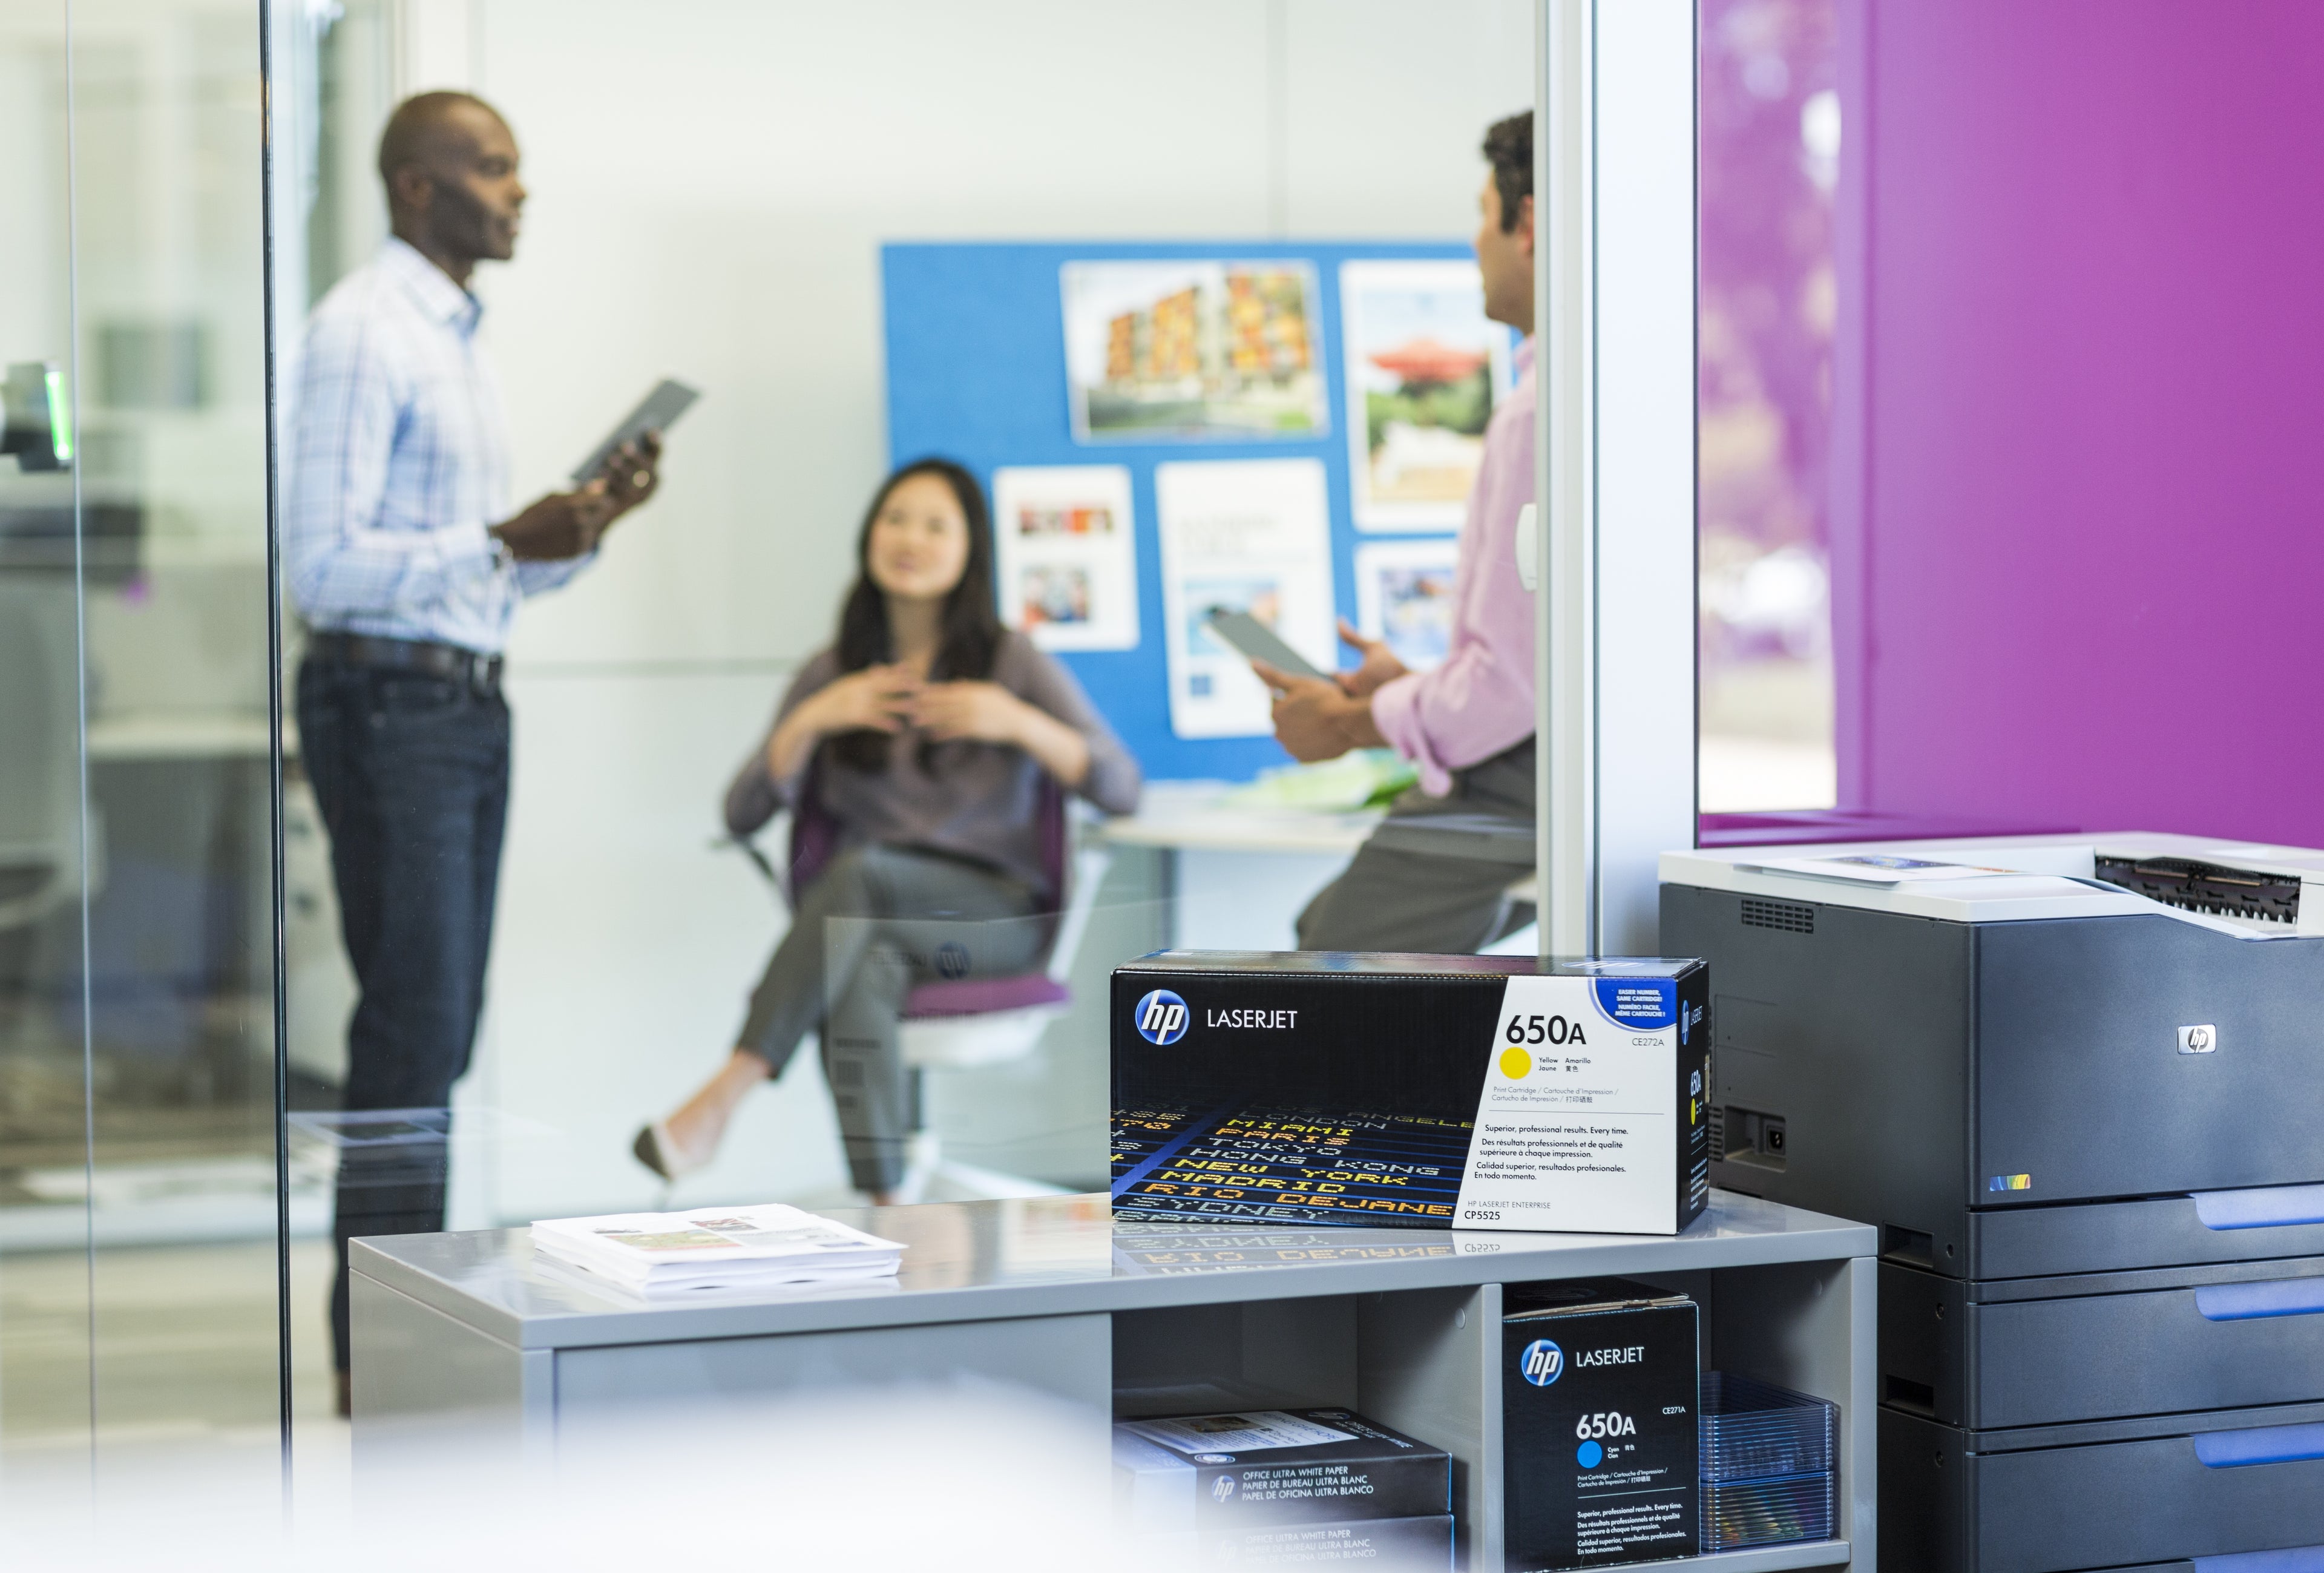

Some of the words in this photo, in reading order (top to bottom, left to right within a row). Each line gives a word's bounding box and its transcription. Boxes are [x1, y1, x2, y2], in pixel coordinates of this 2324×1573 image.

[1141, 989, 1185, 1045] hp
[1207, 1009, 1298, 1028] LASERJET
[1506, 1014, 1586, 1045] 650A
[1632, 1038, 1664, 1046] CE272A
[2190, 1025, 2207, 1053] hp
[1691, 1069, 1701, 1097] 650A
[1227, 1119, 1353, 1136] MIAMI
[1239, 1110, 1387, 1129] LONDON
[1216, 1128, 1350, 1145] PARIS
[1485, 1125, 1517, 1133] Superior,
[1519, 1125, 1561, 1134] professional
[1590, 1127, 1610, 1135] Every
[1209, 1138, 1341, 1155] TOKYO
[1528, 1140, 1578, 1149] professionnels
[1598, 1141, 1623, 1150] qualité
[1190, 1148, 1307, 1164] HONG
[1334, 1160, 1440, 1175] KONG
[1480, 1149, 1517, 1157] supérieure
[1525, 1149, 1551, 1158] chaque
[1552, 1150, 1593, 1159] impression.
[1175, 1159, 1268, 1174] NEW
[1301, 1169, 1408, 1185] YORK
[1506, 1163, 1537, 1172] superior,
[1539, 1163, 1575, 1172] resultados
[1577, 1164, 1626, 1173] profesionales.
[1160, 1171, 1345, 1193] MADRID
[1144, 1183, 1244, 1199] RIO
[1128, 1197, 1329, 1219] SYDNEY
[1465, 1210, 1500, 1220] CP5525
[1526, 1340, 1560, 1386] hp
[1577, 1346, 1644, 1367] LASERJET
[1662, 1405, 1686, 1415] CE271A
[1576, 1412, 1636, 1440] 650A
[1243, 1471, 1270, 1480] OFFICE
[1273, 1470, 1296, 1478] ULTRA
[1298, 1468, 1323, 1477] WHITE
[1325, 1466, 1348, 1475] PAPER
[1213, 1475, 1235, 1503] hp
[1243, 1482, 1267, 1491] PAPIER
[1270, 1480, 1280, 1489] DE
[1282, 1479, 1313, 1488] BUREAU
[1316, 1477, 1338, 1486] ULTRA
[1341, 1475, 1367, 1485] BLANC
[1242, 1492, 1264, 1501] PAPEL
[1279, 1489, 1313, 1499] OFICINA
[1315, 1488, 1338, 1497] ULTRA
[1341, 1485, 1374, 1495] BLANCO
[1603, 1506, 1635, 1517] professional
[1611, 1516, 1648, 1526] professionnels
[1662, 1513, 1680, 1522] qualité
[1246, 1535, 1273, 1544] OFFICE
[1276, 1533, 1299, 1542] ULTRA
[1301, 1531, 1325, 1540] WHITE
[1328, 1529, 1351, 1539] PAPER
[1577, 1528, 1606, 1537] supérieure
[1630, 1523, 1661, 1532] impression.
[1246, 1545, 1270, 1554] PAPIER
[1273, 1544, 1283, 1553] DE
[1285, 1543, 1316, 1552] BUREAU
[1318, 1541, 1341, 1550] ULTRA
[1344, 1539, 1370, 1548] BLANC
[1599, 1537, 1622, 1546] superior,
[1623, 1534, 1650, 1543] resultados
[1650, 1531, 1687, 1541] profesionales.
[1282, 1553, 1315, 1563] OFICINA
[1318, 1551, 1341, 1561] ULTRA
[1343, 1549, 1376, 1559] BLANCO
